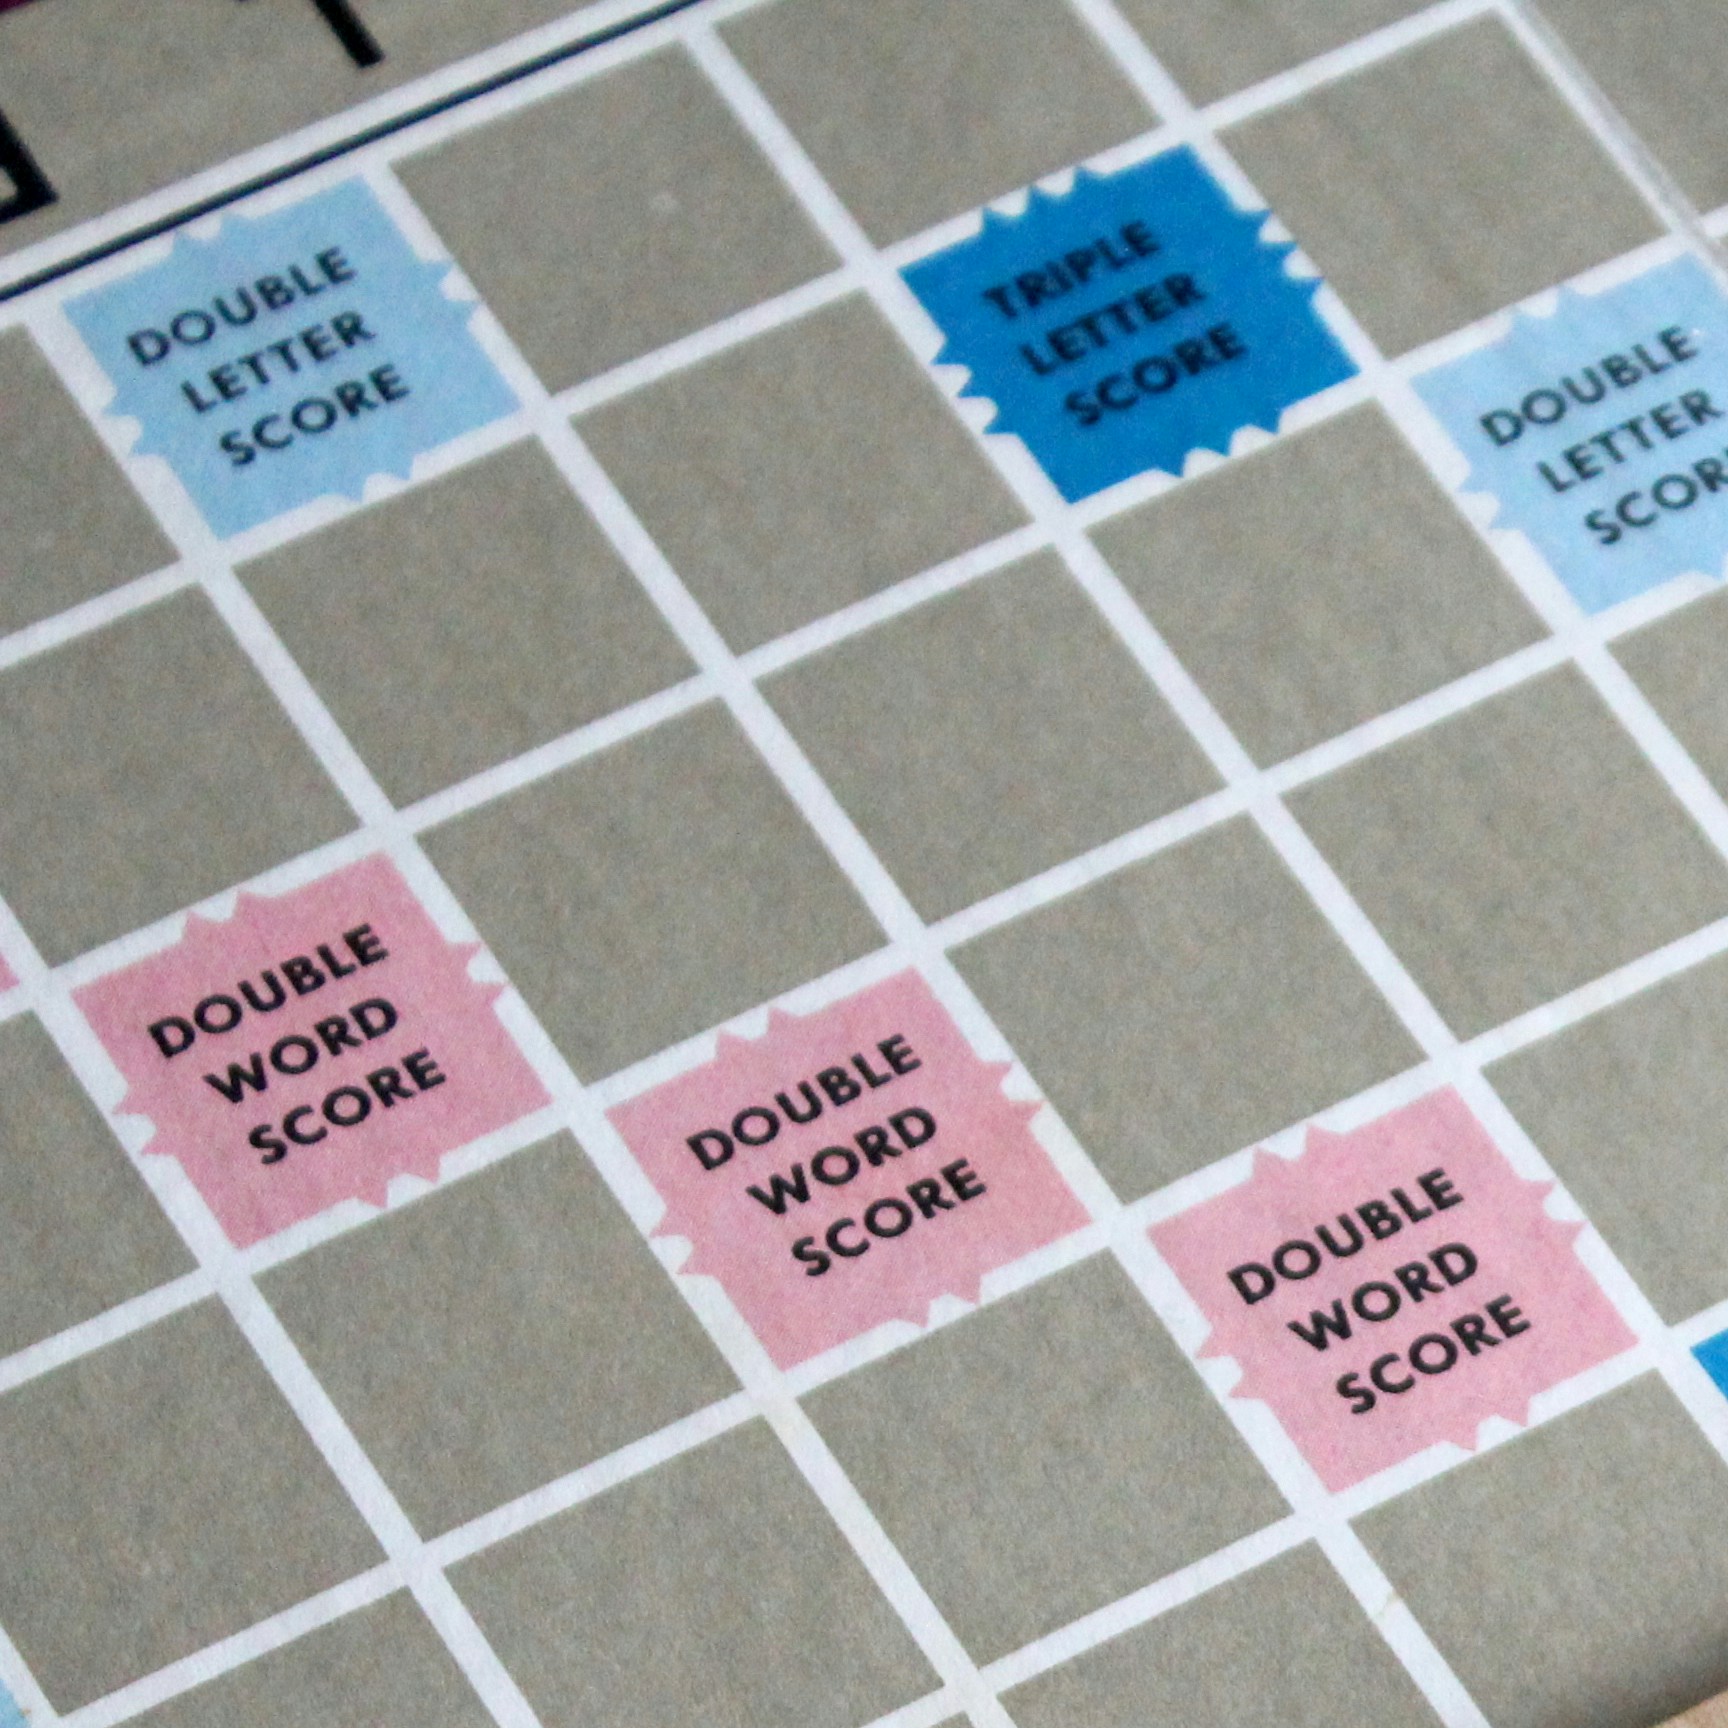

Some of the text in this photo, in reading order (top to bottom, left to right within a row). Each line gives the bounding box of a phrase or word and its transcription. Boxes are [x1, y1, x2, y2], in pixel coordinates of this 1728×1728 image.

[126, 248, 353, 368] DOUBLE
[981, 219, 1162, 321] TRIPLE
[1018, 272, 1206, 379] LETTER
[180, 311, 371, 414] LETTER
[218, 365, 408, 467] SCORE
[1062, 322, 1247, 429] SCORE
[1477, 325, 1698, 450] DOUBLE
[1536, 388, 1723, 496] LETTER
[146, 923, 389, 1060] DOUBLE
[203, 997, 399, 1105] WORD
[685, 1034, 922, 1172] DOUBLE
[247, 1049, 447, 1166] SCORE
[745, 1107, 938, 1216] WORD
[790, 1158, 987, 1278] SCORE
[1226, 1168, 1464, 1307] DOUBLE
[1286, 1242, 1479, 1353] WORD
[1335, 1294, 1532, 1416] SCORE
